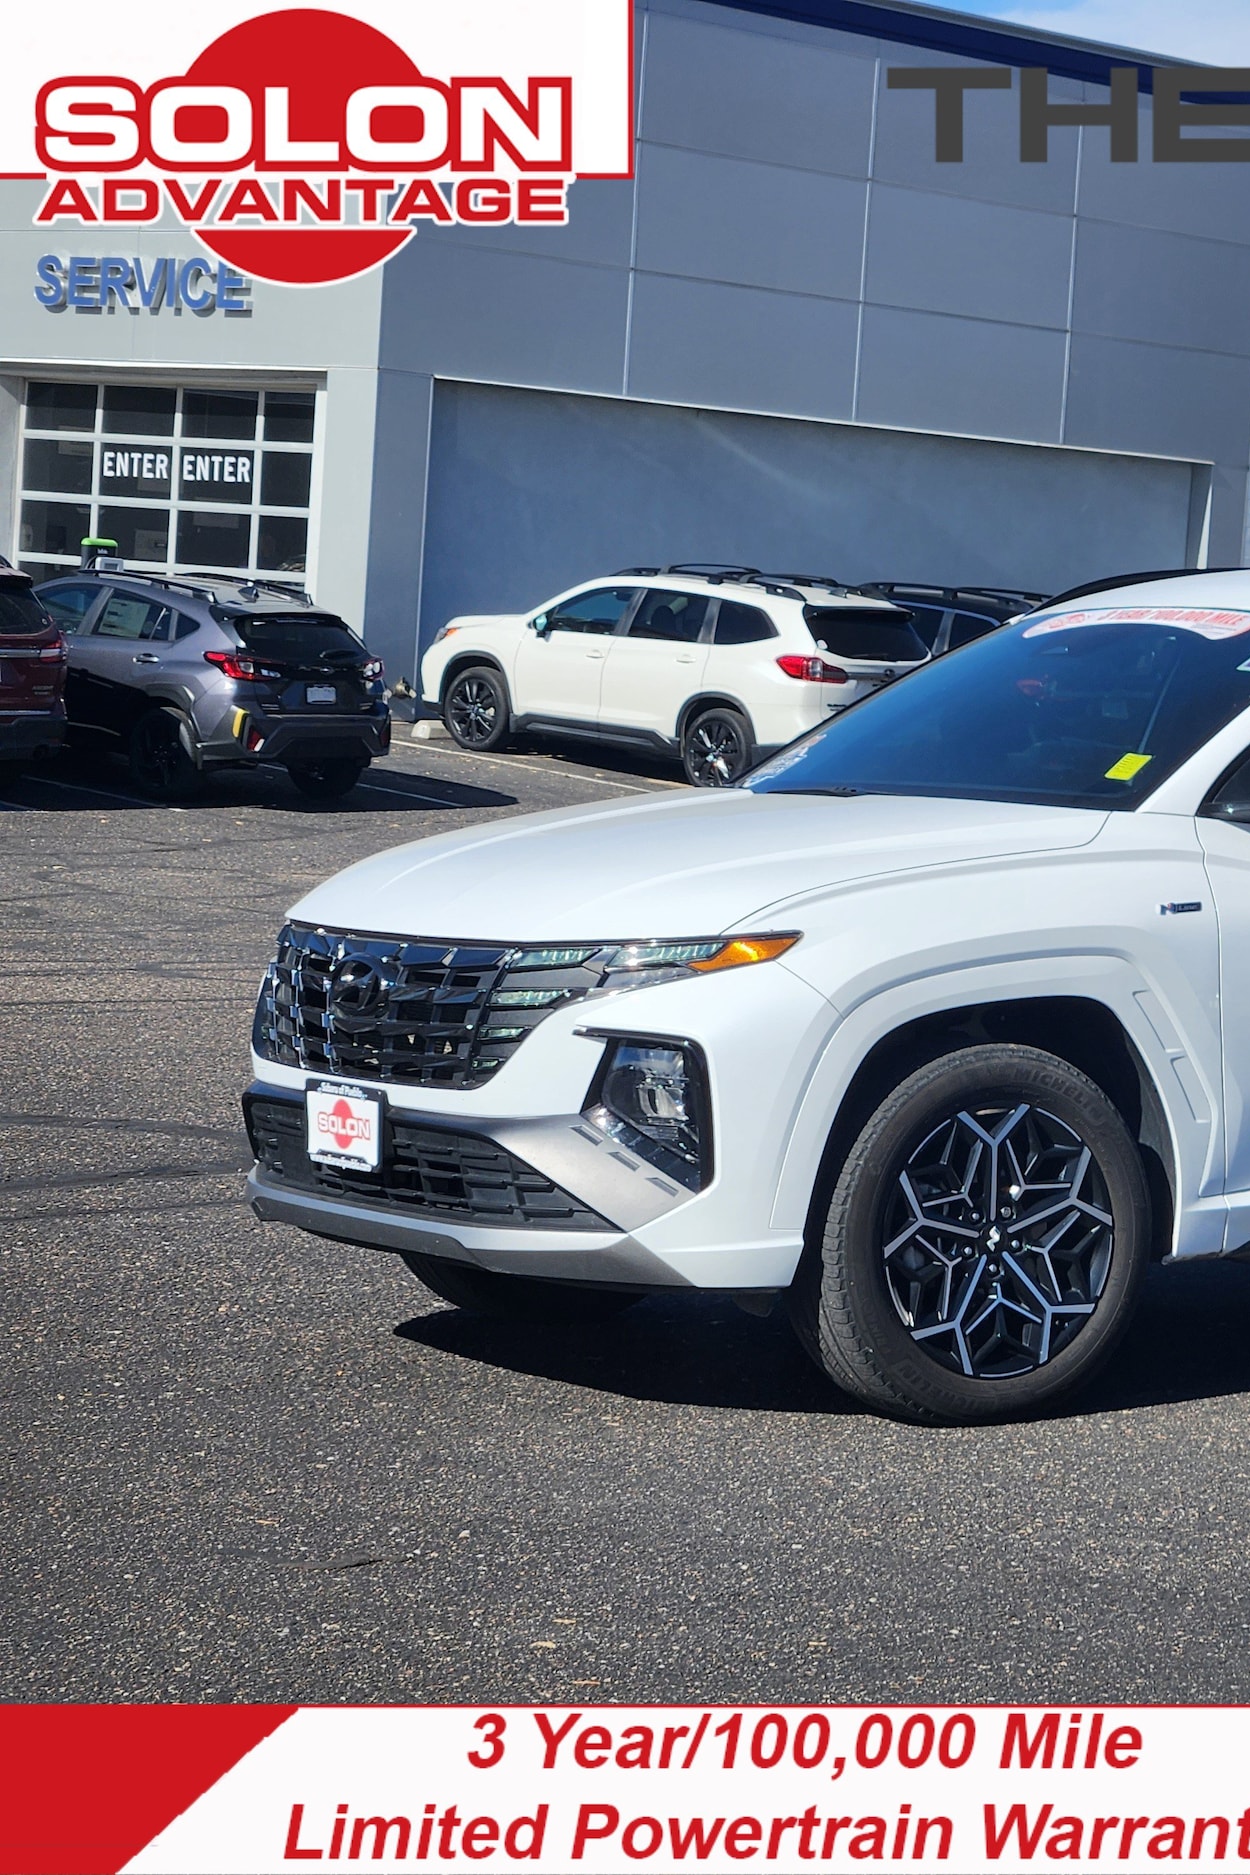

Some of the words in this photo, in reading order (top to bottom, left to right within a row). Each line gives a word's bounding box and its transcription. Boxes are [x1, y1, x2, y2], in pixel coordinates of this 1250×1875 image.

[34, 254, 249, 312] SERVICE
[103, 452, 168, 480] ENTER
[182, 454, 251, 483] ENTER
[318, 1112, 371, 1140] SOLON
